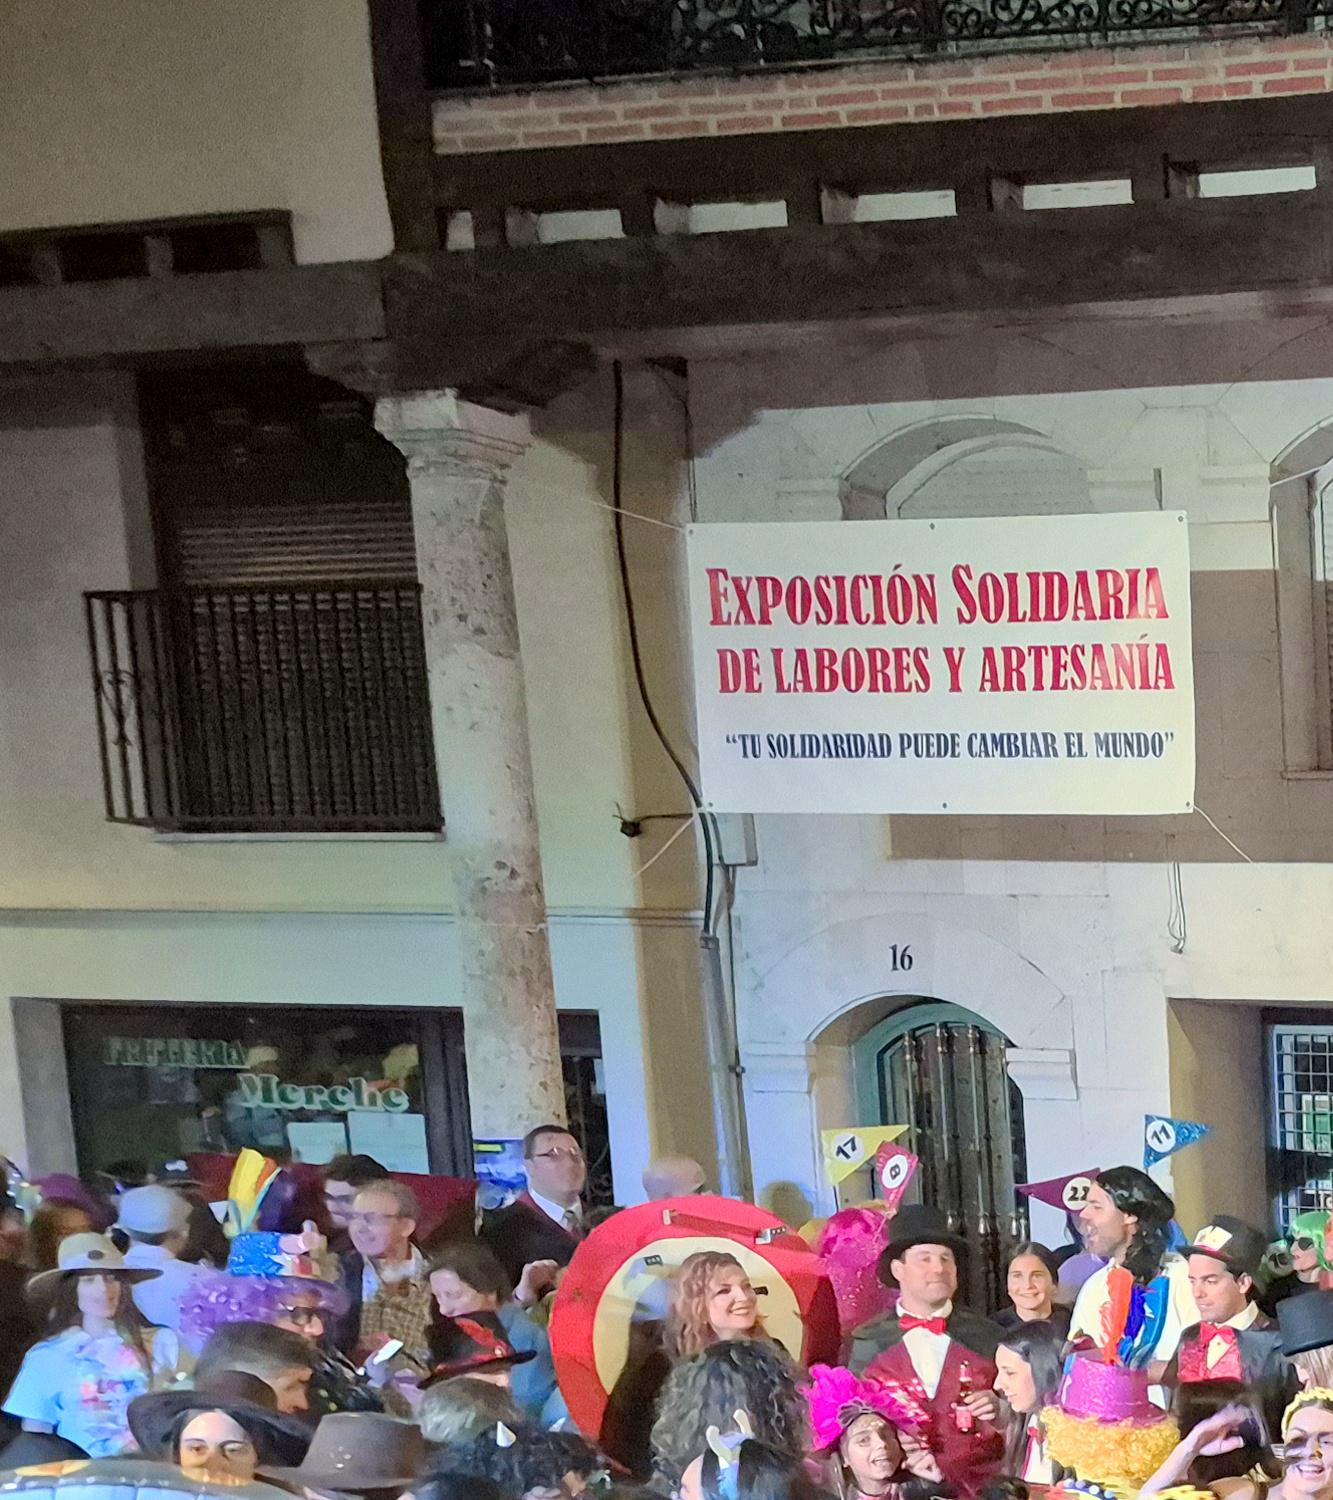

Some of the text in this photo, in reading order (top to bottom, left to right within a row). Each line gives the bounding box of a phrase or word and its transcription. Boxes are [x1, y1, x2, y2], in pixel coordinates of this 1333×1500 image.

[705, 563, 1169, 625] EXPOSICIÓN SOLIDARIA
[716, 633, 1175, 693] DE LABORES Y ARTESANÍA
[766, 733, 892, 759] SOLIDARIDAD
[899, 733, 960, 758] PUEDE
[967, 732, 1059, 758] CAMBIAR
[1064, 732, 1088, 758] EL
[888, 943, 913, 971] 16
[236, 1073, 410, 1112] Merche
[836, 1135, 857, 1160] 17
[1151, 1124, 1171, 1145] 11
